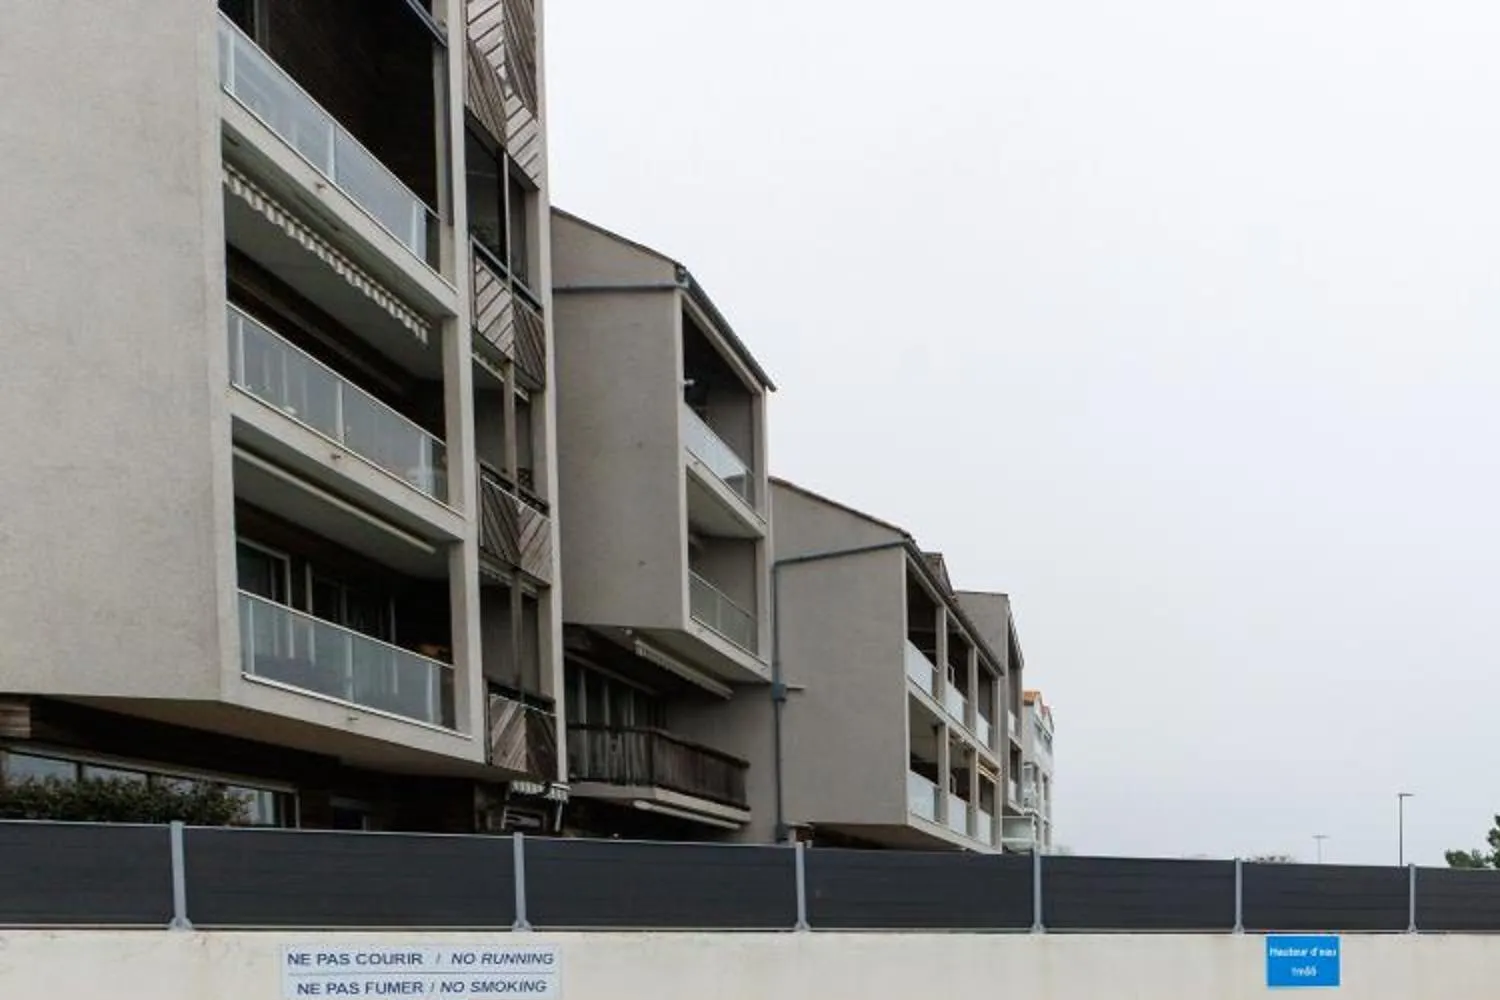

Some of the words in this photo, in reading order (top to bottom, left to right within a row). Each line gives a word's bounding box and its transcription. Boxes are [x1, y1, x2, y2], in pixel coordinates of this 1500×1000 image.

[287, 953, 311, 966] NE
[316, 953, 350, 965] PAS
[355, 953, 423, 965] COURIR
[451, 953, 476, 965] NO
[481, 953, 554, 965] RUNNING
[297, 983, 321, 995] NE
[326, 983, 360, 995] PAS
[364, 981, 424, 995] FUMER
[440, 981, 465, 993] NO
[470, 979, 548, 993] SMOKING
